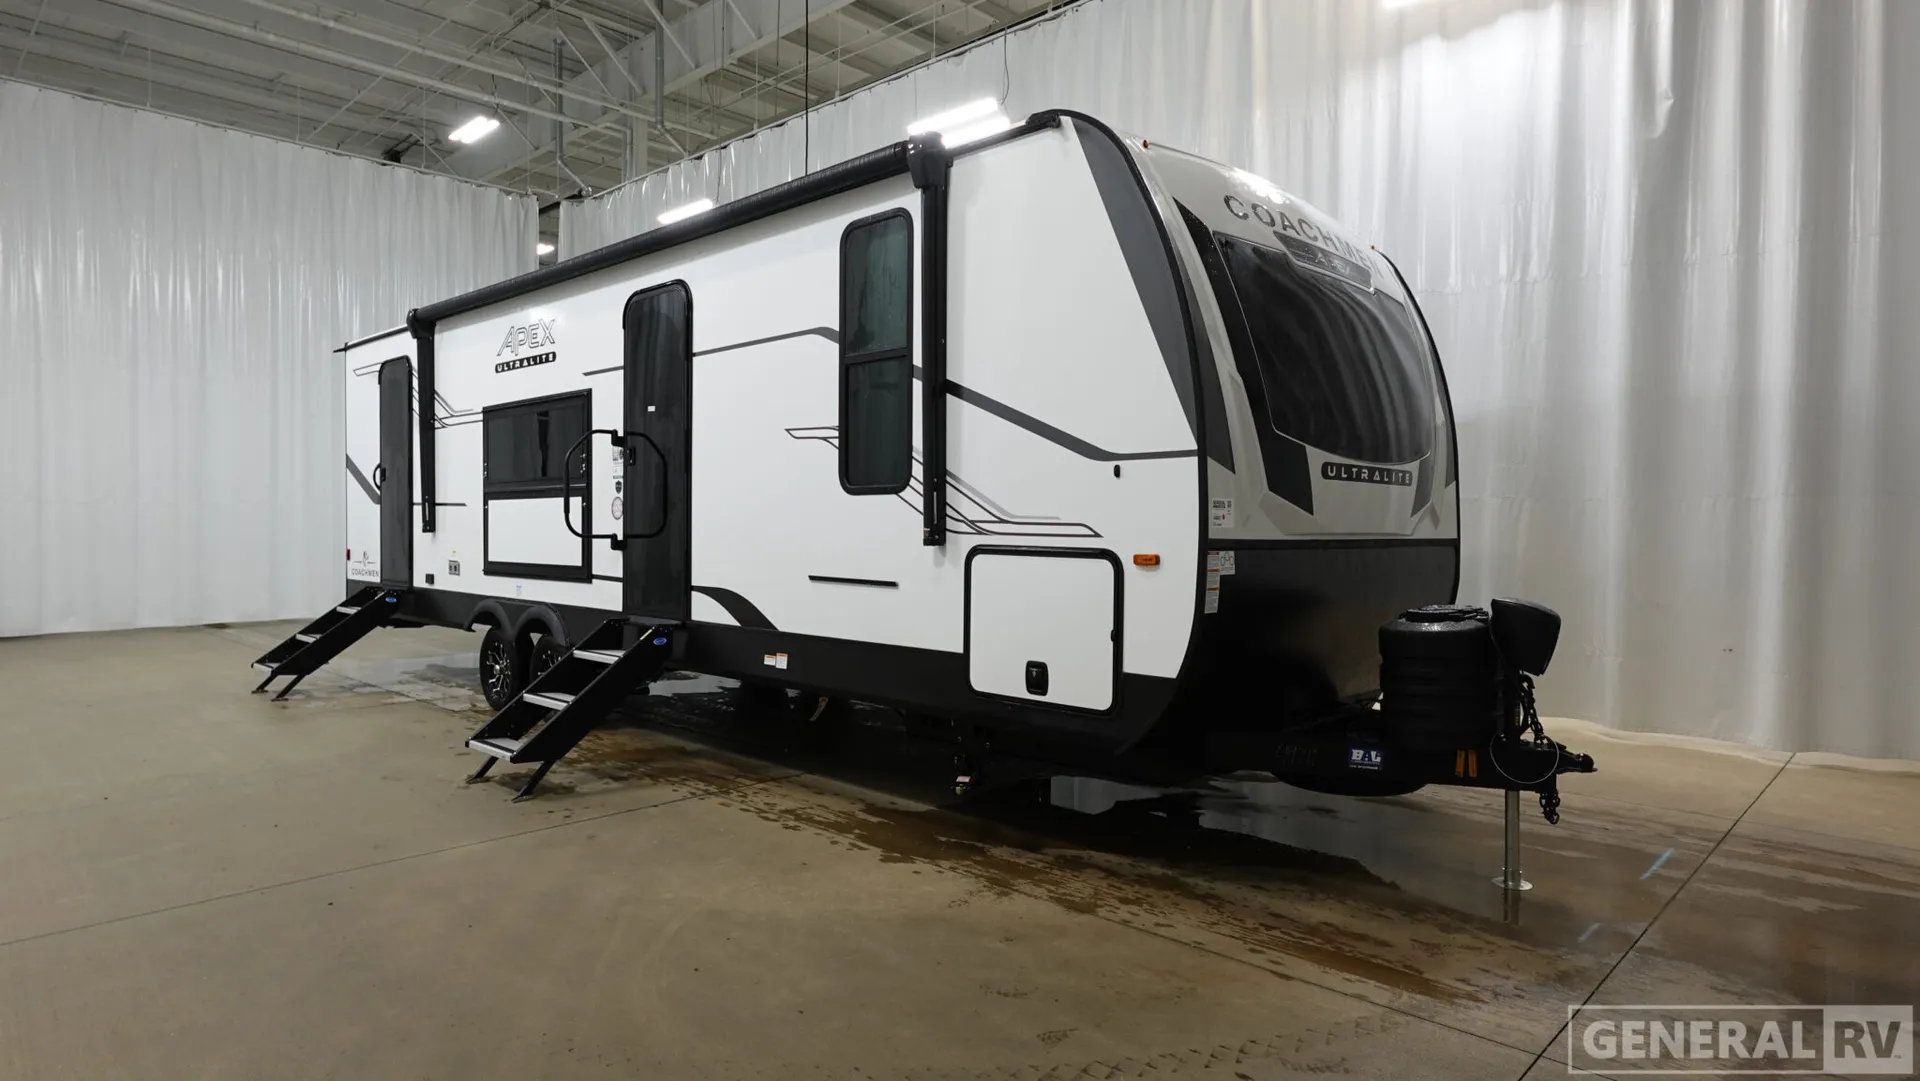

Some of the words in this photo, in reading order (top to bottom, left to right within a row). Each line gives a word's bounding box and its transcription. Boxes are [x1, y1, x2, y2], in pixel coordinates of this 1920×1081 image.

[497, 318, 556, 356] APEX
[497, 353, 554, 372] ULTRALITE
[1327, 465, 1410, 484] ULTRALITE
